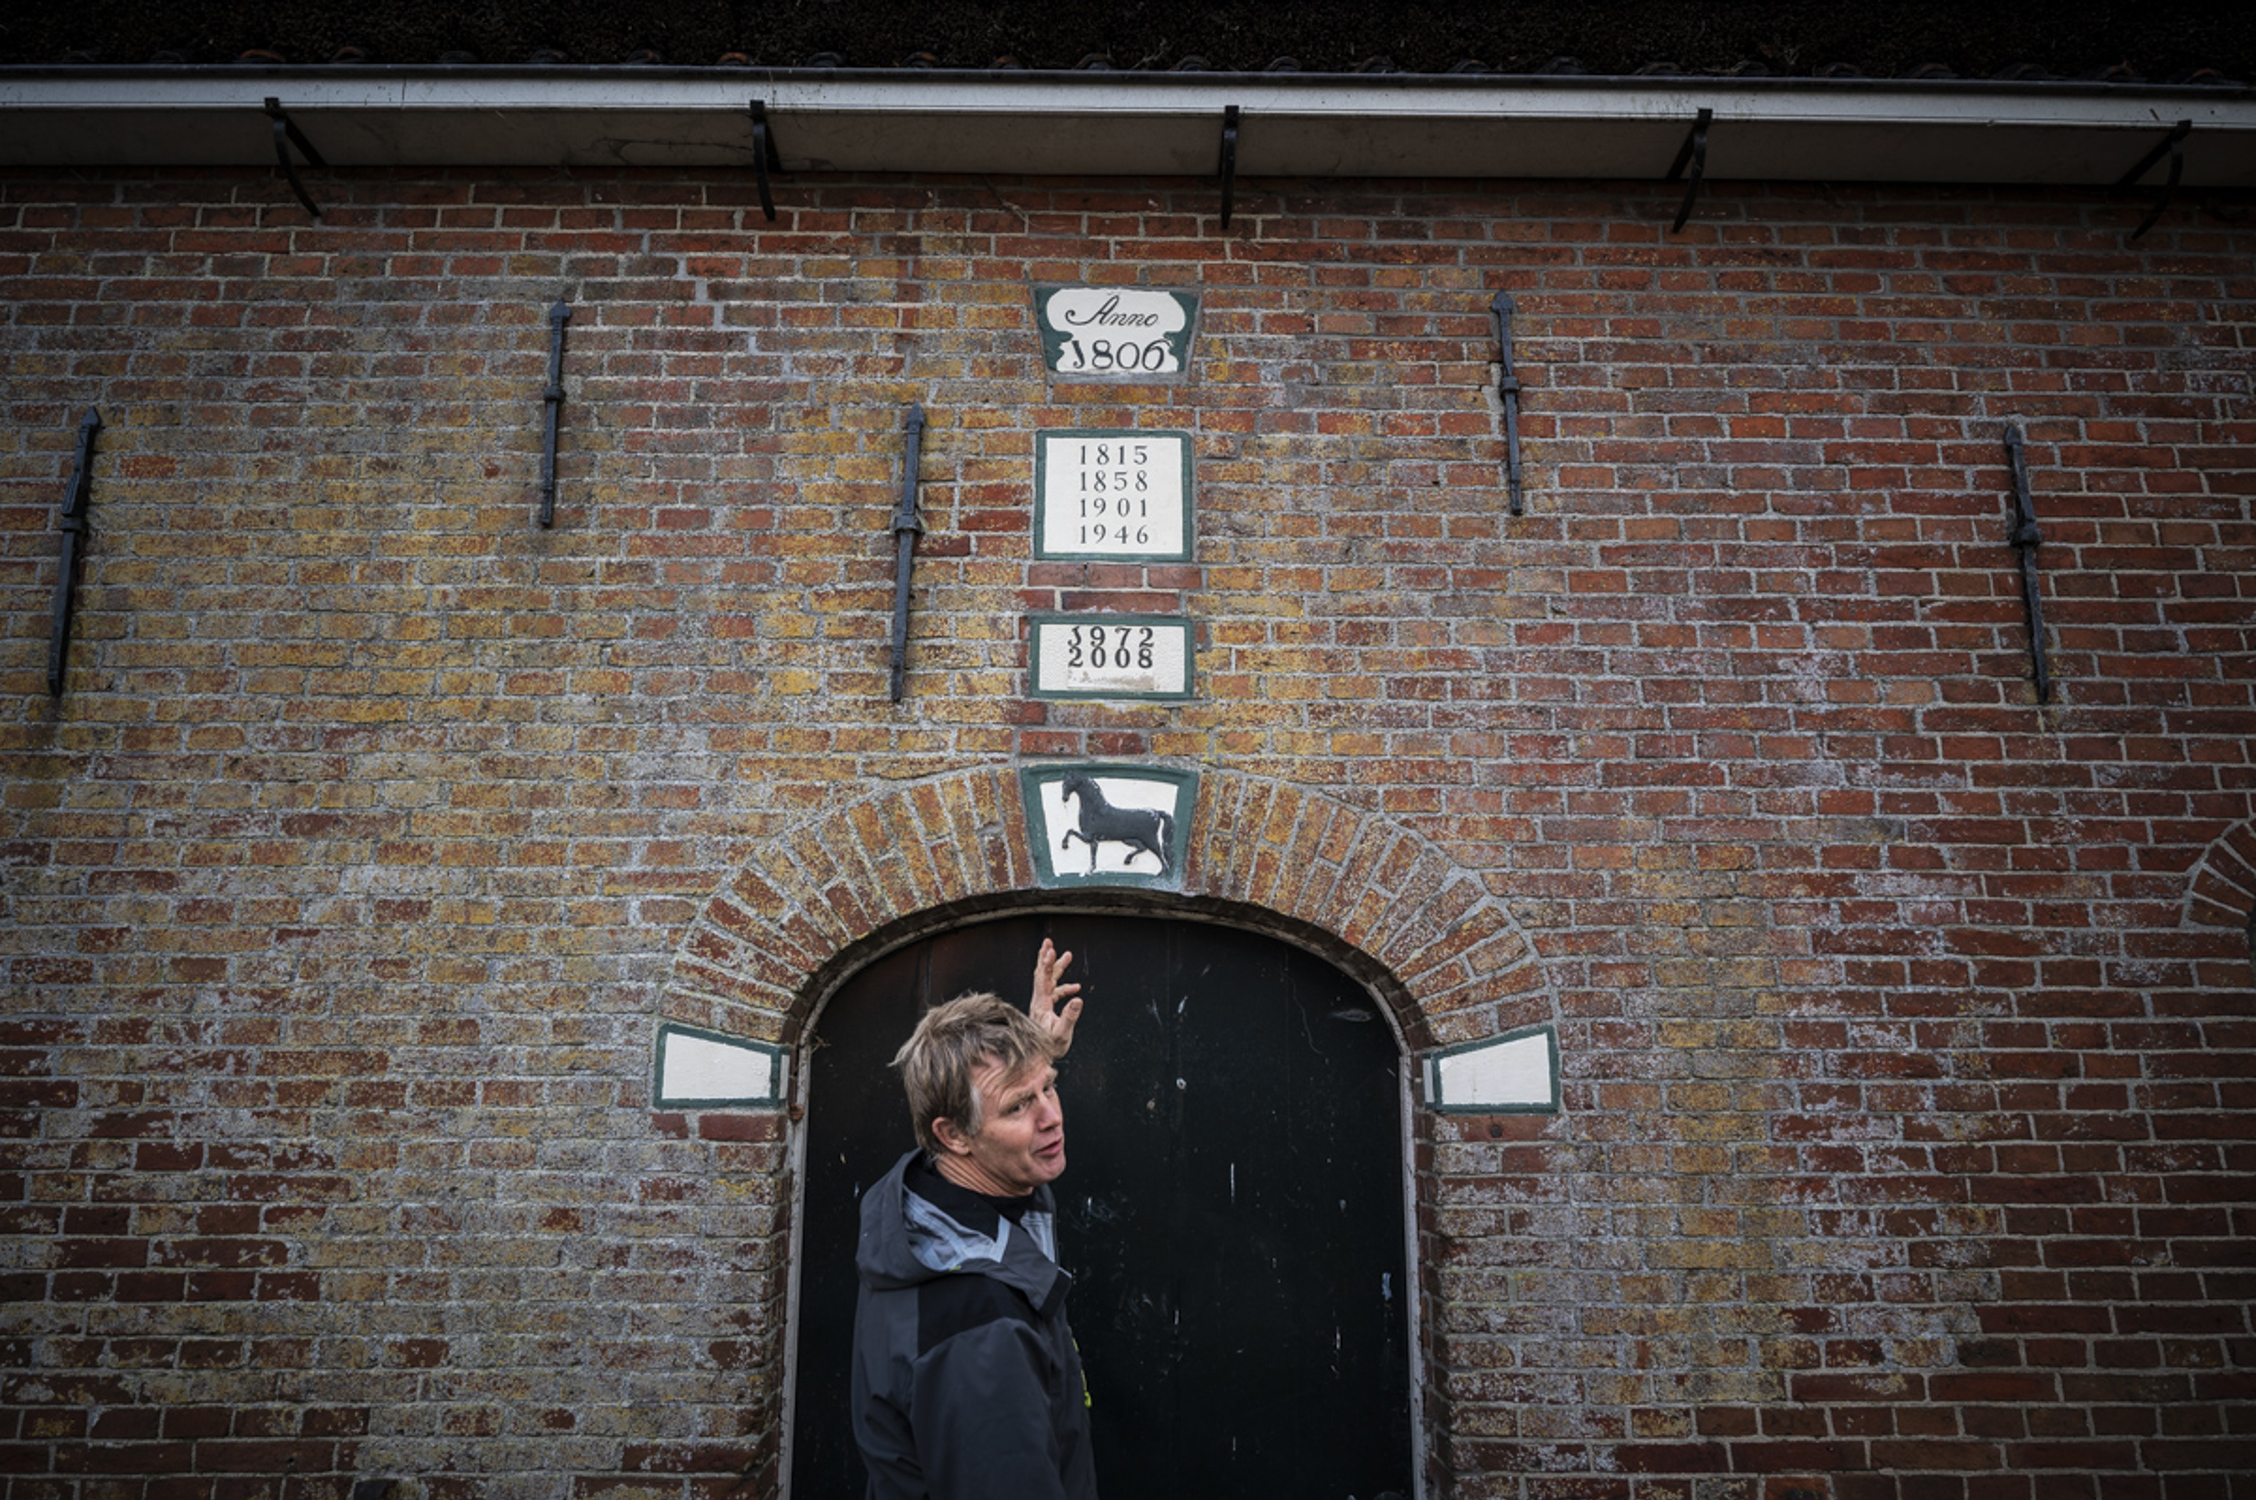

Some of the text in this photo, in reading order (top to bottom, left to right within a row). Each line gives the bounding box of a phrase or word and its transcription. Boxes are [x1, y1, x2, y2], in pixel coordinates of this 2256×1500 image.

[1065, 295, 1159, 326] Anno
[1071, 338, 1173, 371] 1806
[1080, 443, 1148, 465] 1815
[1080, 470, 1148, 492] 1858
[1080, 498, 1147, 518] 1901
[1080, 524, 1149, 544] 1946
[1067, 625, 1154, 647] 1972
[1067, 646, 1154, 669] 2008
